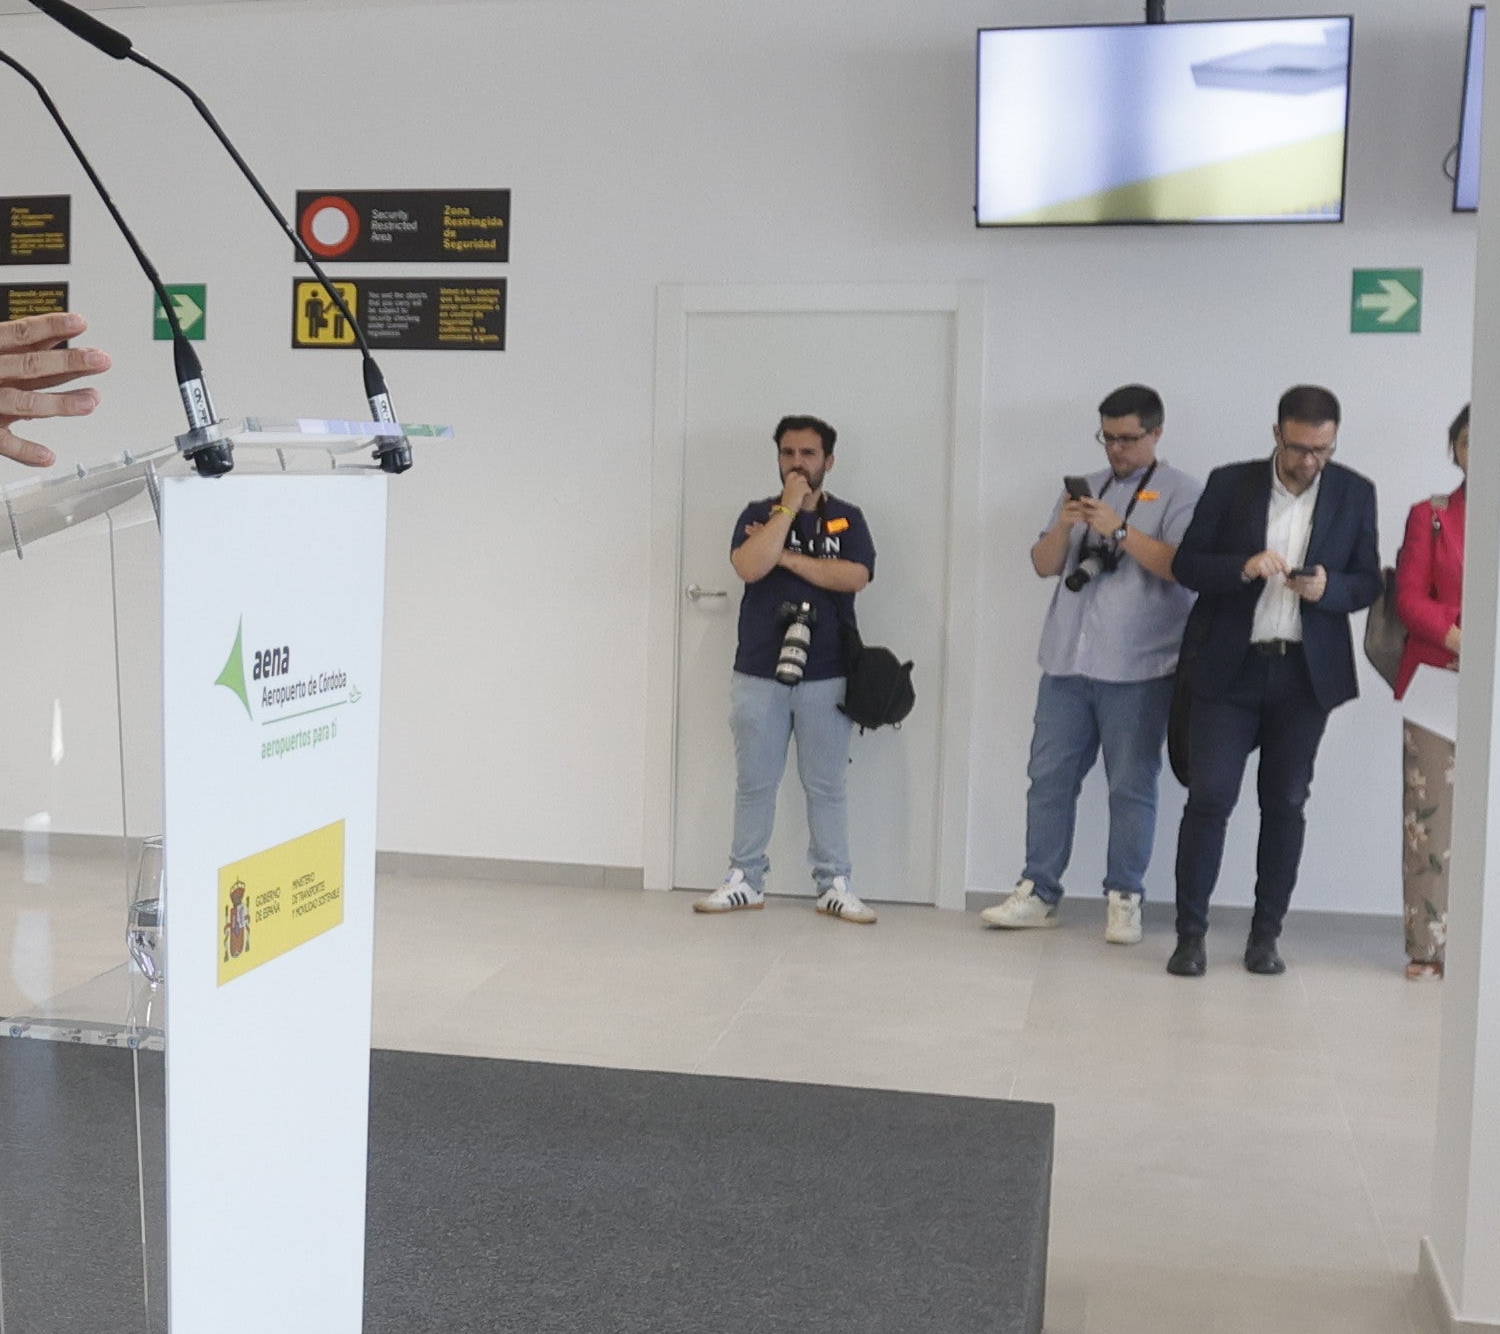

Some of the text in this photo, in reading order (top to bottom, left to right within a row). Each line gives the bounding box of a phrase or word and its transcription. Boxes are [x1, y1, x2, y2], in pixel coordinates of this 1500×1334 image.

[371, 209, 408, 220] Security
[444, 205, 470, 216] Zona
[371, 220, 418, 231] Restricted
[443, 217, 504, 228] Restringida
[371, 232, 392, 242] Area
[443, 228, 457, 238] de
[443, 239, 496, 251] Seguridad
[252, 645, 291, 682] aena
[261, 668, 348, 708] Aeropuerto de Córdoba
[260, 729, 312, 760] aeropuertos
[312, 723, 331, 748] para
